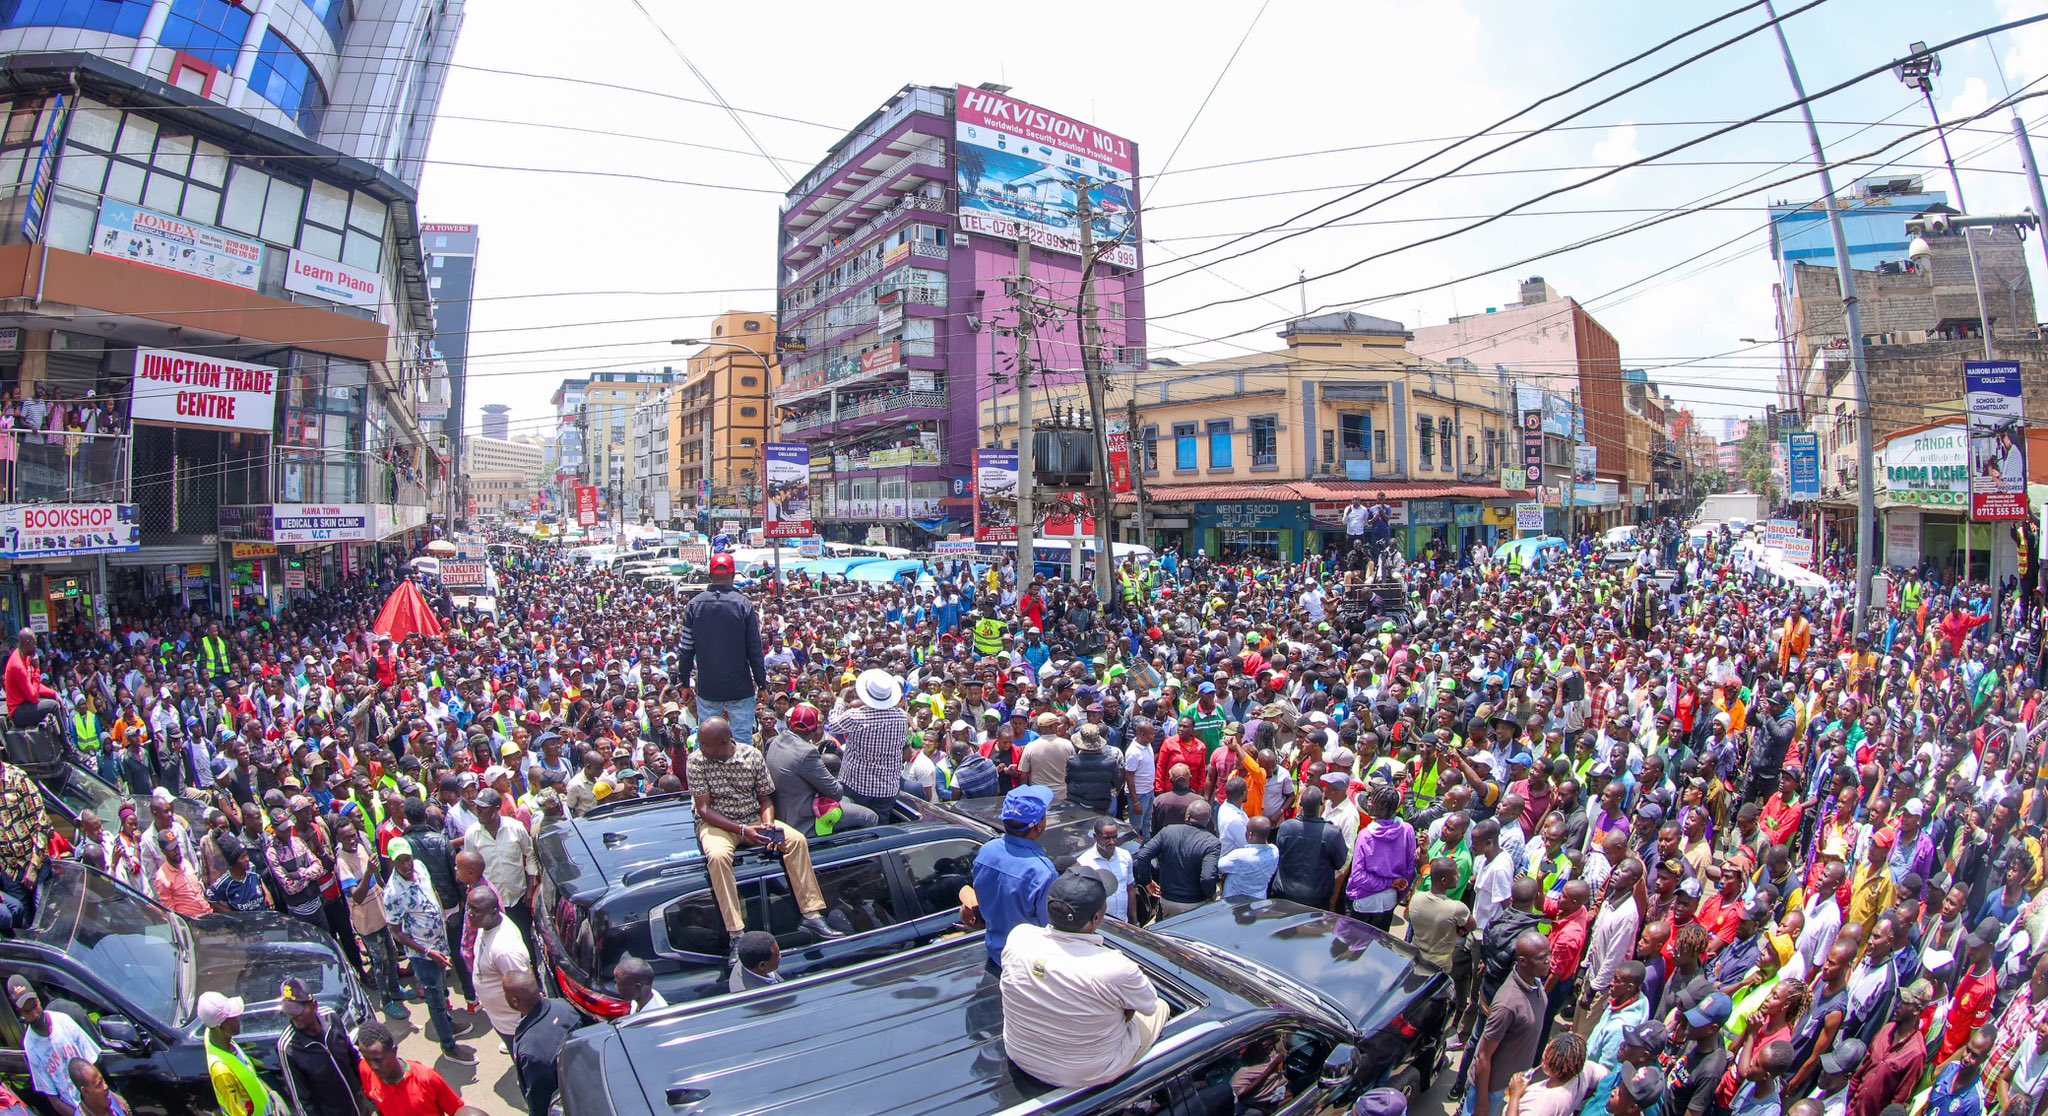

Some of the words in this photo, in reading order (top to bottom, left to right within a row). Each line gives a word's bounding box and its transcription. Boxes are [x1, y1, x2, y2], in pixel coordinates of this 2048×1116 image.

[963, 91, 1086, 143] HIKVISION
[1093, 131, 1127, 158] NO.1
[984, 116, 1023, 135] Worldwide
[1026, 128, 1056, 146] Security
[1057, 138, 1086, 154] Solution
[1087, 147, 1114, 163] Provider
[134, 212, 198, 238] JOMEX
[135, 225, 164, 238] MEDICAL
[164, 231, 195, 245] SUPPLIES
[226, 239, 239, 248] 0710
[225, 246, 238, 256] 0742
[295, 260, 334, 283] Learn
[338, 272, 374, 294] Piano
[141, 354, 222, 388] JUNCTION
[225, 366, 273, 395] TRADE
[176, 390, 236, 420] CENTRE
[1915, 436, 1953, 451] RANDA
[1887, 465, 1928, 481] RANDA
[1931, 465, 1968, 482] DISHE
[302, 507, 321, 515] HAWA
[1216, 505, 1242, 514] NENO
[1246, 504, 1279, 513] SACCO
[1996, 507, 2010, 515] 555
[2011, 507, 2025, 515] 558
[25, 508, 112, 529] BOOKSHOP
[281, 519, 311, 528] MEDICAL
[313, 519, 319, 528] &
[321, 518, 336, 527] SKIN
[337, 517, 359, 527] CLINIC
[1222, 514, 1261, 523] SHUTTLE
[312, 529, 332, 539] V.C.T
[1768, 526, 1796, 534] ISIOLO
[236, 548, 277, 556] SIMU
[442, 565, 482, 573] NAKURU
[443, 574, 484, 583] SHUTTLE
